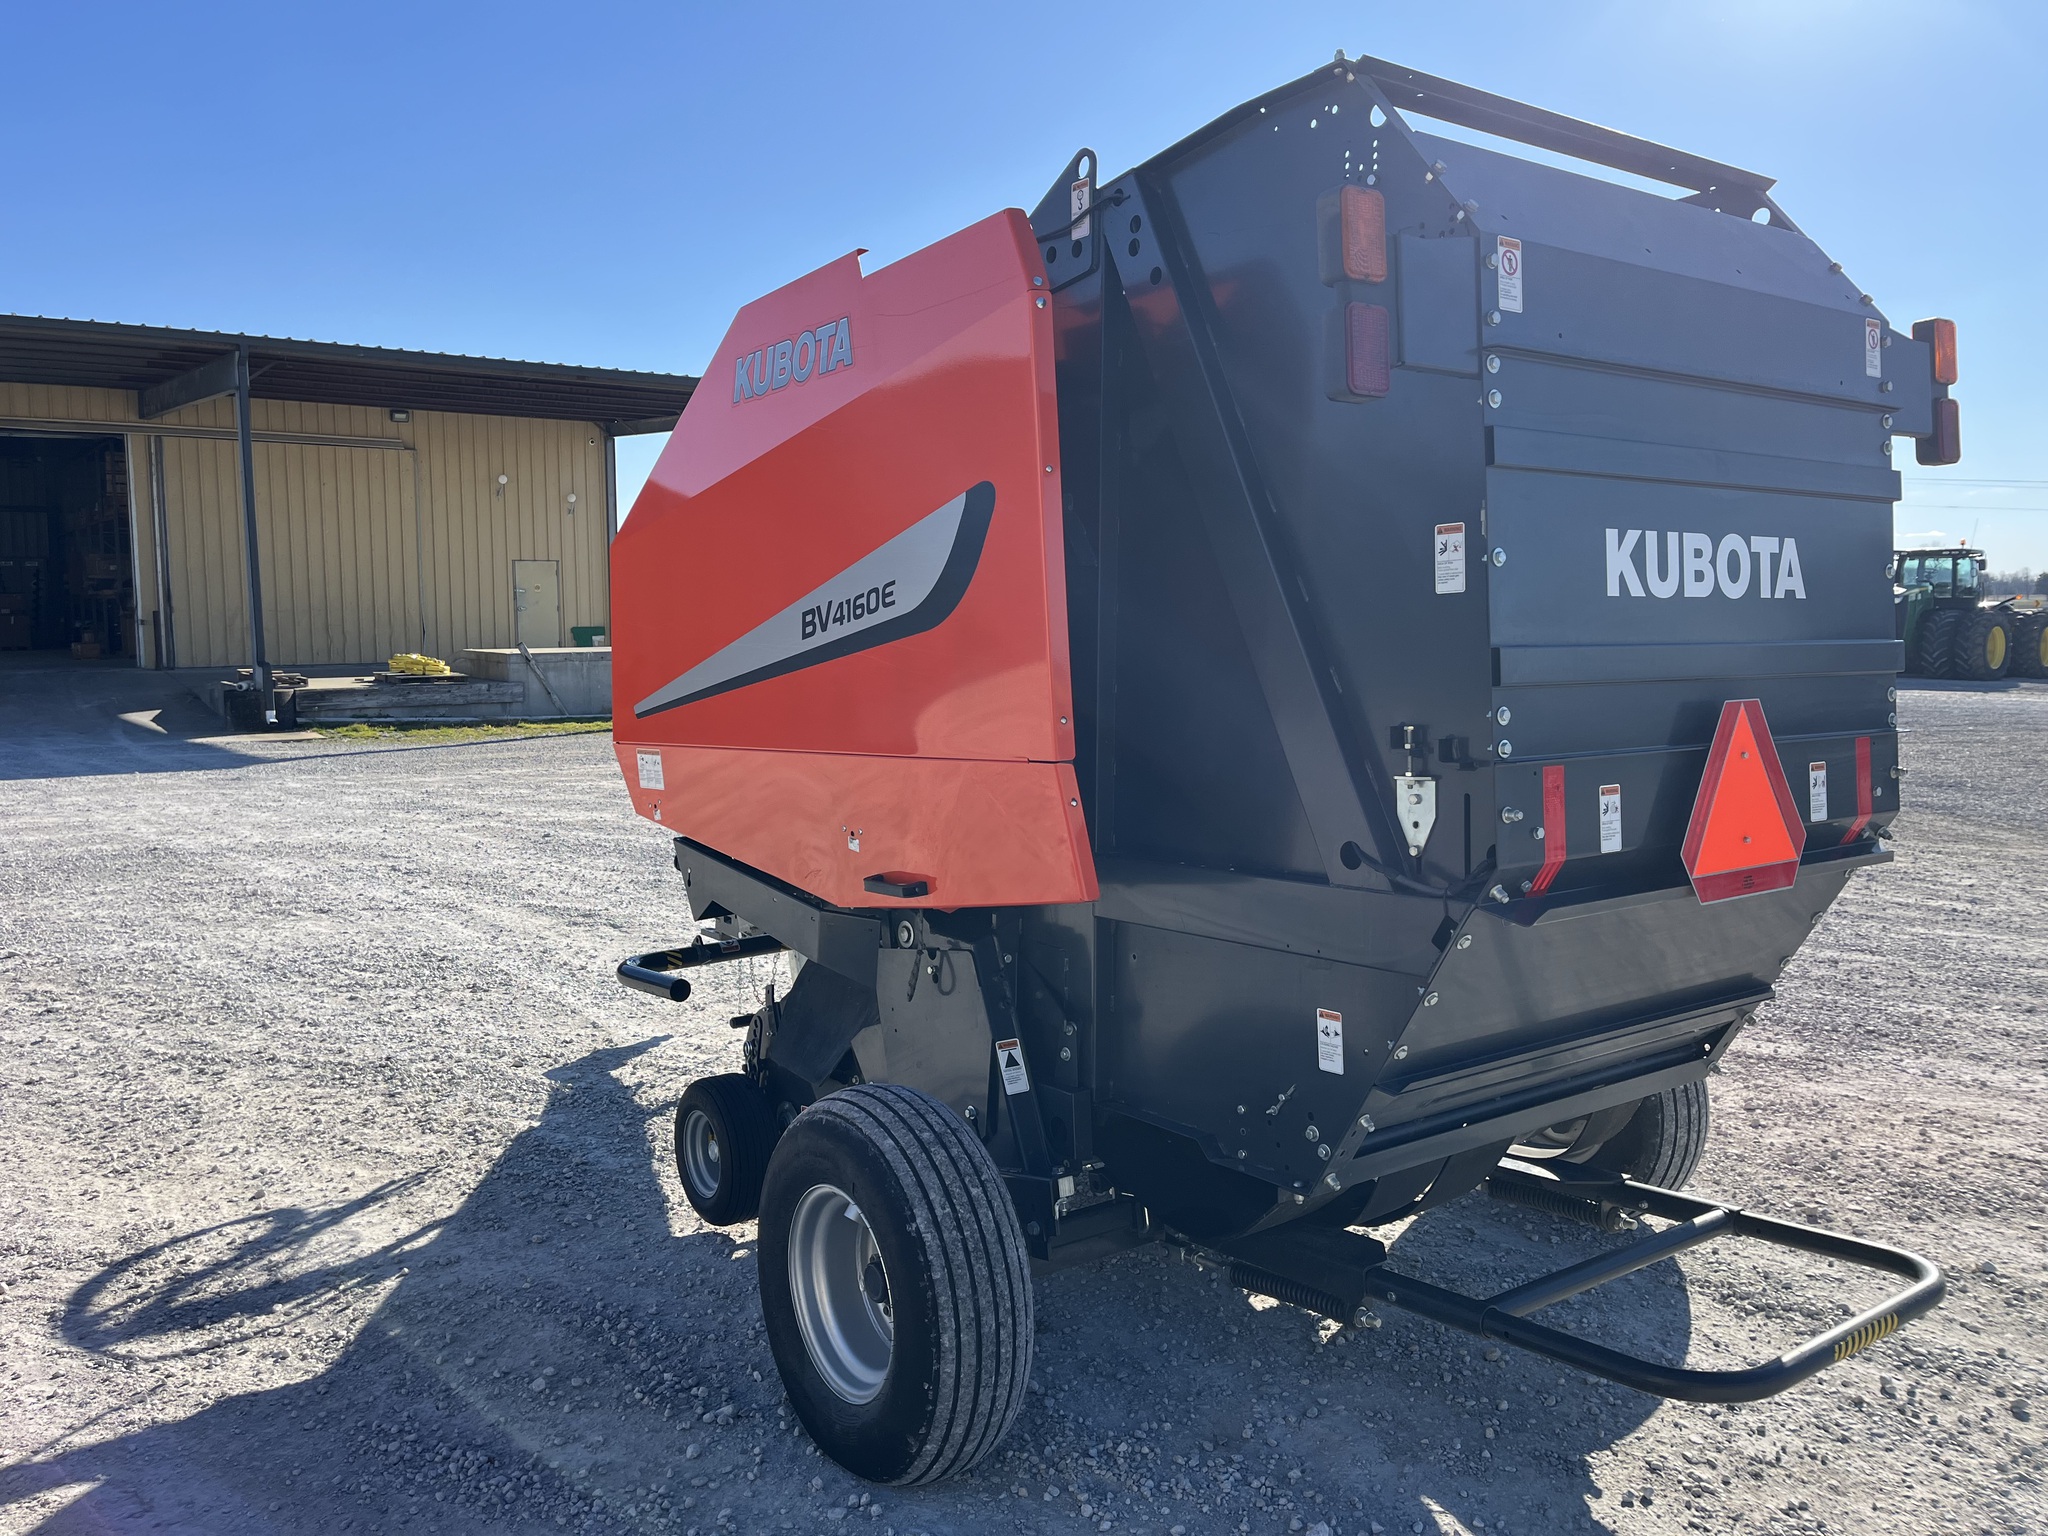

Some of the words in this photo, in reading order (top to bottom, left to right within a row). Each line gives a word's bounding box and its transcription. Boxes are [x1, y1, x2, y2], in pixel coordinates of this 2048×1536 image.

[733, 316, 853, 404] KUBOTA
[1605, 528, 1807, 599] KUBOTA
[801, 579, 896, 640] BV4160E
